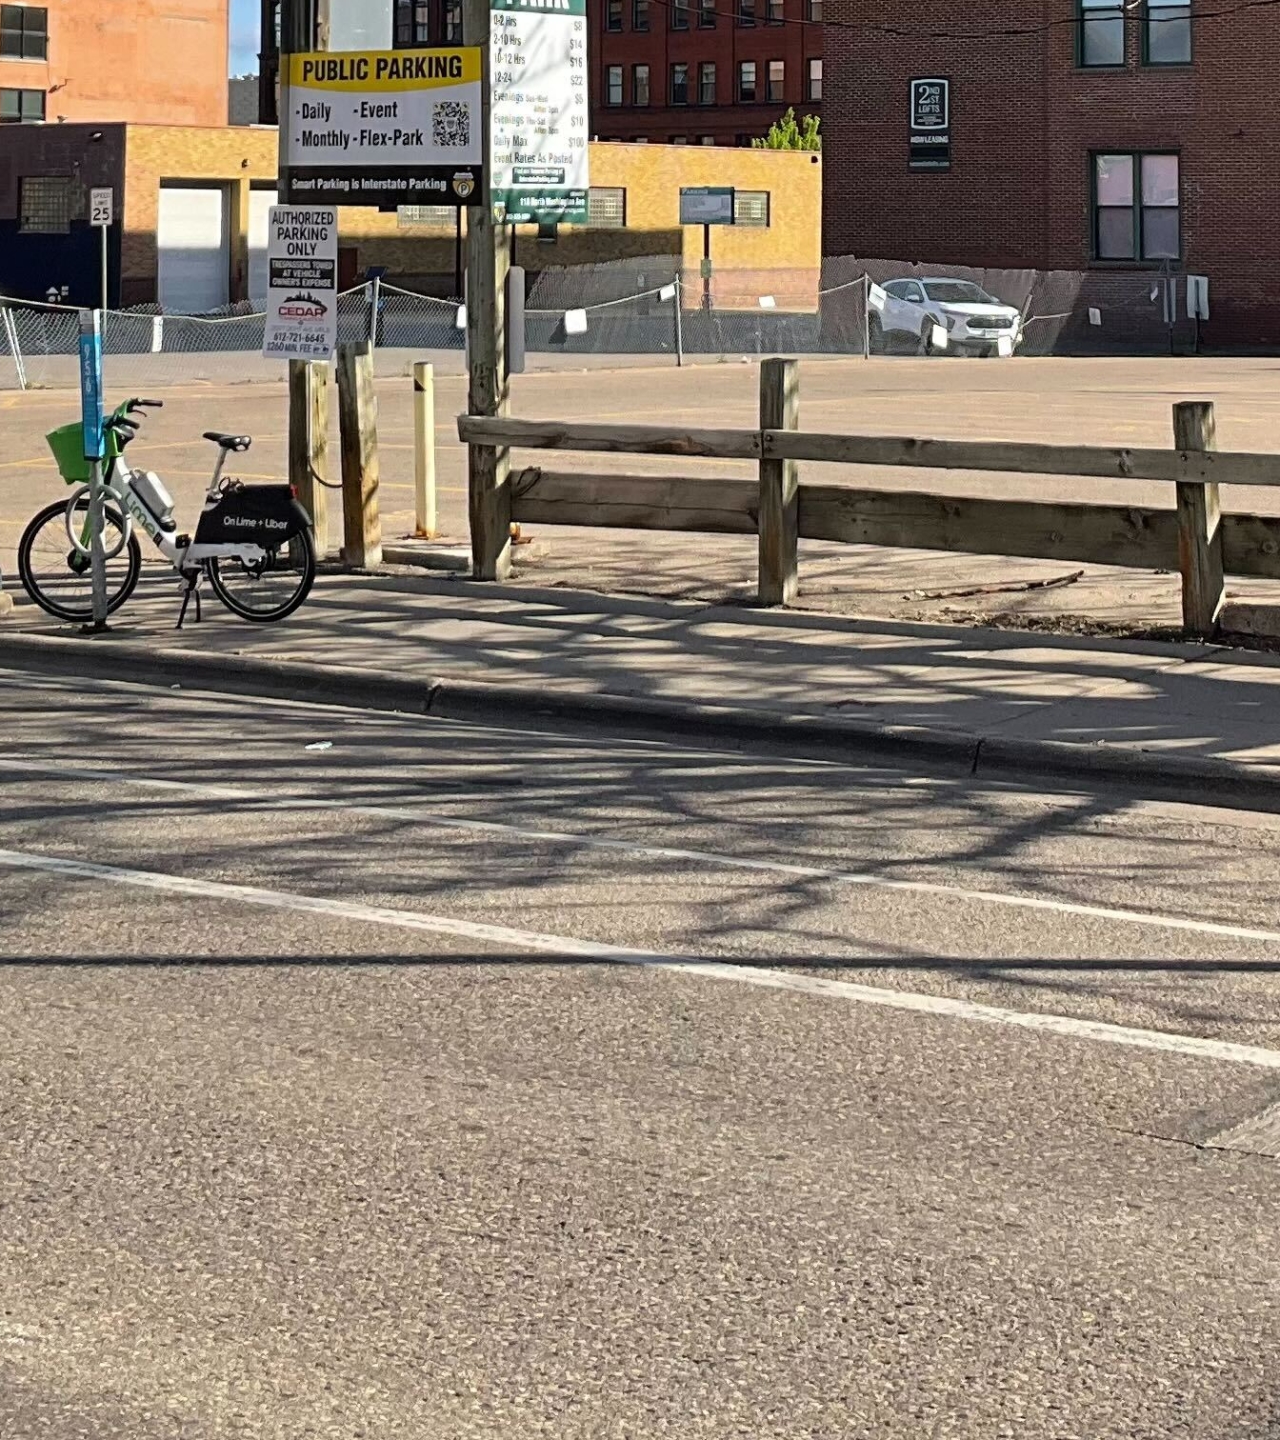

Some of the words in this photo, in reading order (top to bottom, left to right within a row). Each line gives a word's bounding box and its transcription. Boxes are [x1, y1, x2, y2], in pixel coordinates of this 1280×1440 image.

[506, 16, 517, 27] Hrs
[493, 33, 508, 46] 2-10
[509, 34, 522, 47] Hrs
[569, 38, 583, 50] $14
[513, 53, 526, 65] Hrs
[303, 57, 369, 81] PUBLIC
[375, 55, 462, 80] PARKING
[494, 71, 512, 83] 12-24
[493, 90, 524, 104] Evenings
[918, 104, 940, 113] LOFTS
[493, 113, 525, 127] Evenings
[570, 116, 584, 128] $10
[493, 135, 511, 149] Daily
[512, 135, 528, 147] Max
[493, 152, 513, 164] Event
[514, 152, 536, 164] Rates
[537, 153, 547, 164] As
[548, 153, 573, 164] Posted
[292, 178, 315, 190] Smart
[317, 178, 350, 192] Parking
[351, 178, 360, 190] is
[361, 178, 407, 190] Interstate
[408, 178, 447, 192] Parking
[93, 207, 110, 221] 25
[272, 211, 334, 226] AUTHORIZED
[277, 227, 328, 241] PARKING
[287, 242, 317, 256] ONLY
[282, 269, 292, 277] AT
[293, 269, 321, 278] VEHICLE
[302, 278, 332, 287] EXPENSE
[278, 306, 325, 317] CEDAR
[299, 343, 312, 353] FEE
[125, 491, 156, 535] Lime
[223, 516, 235, 526] On
[236, 516, 257, 527] Lime
[265, 517, 289, 530] Uber
